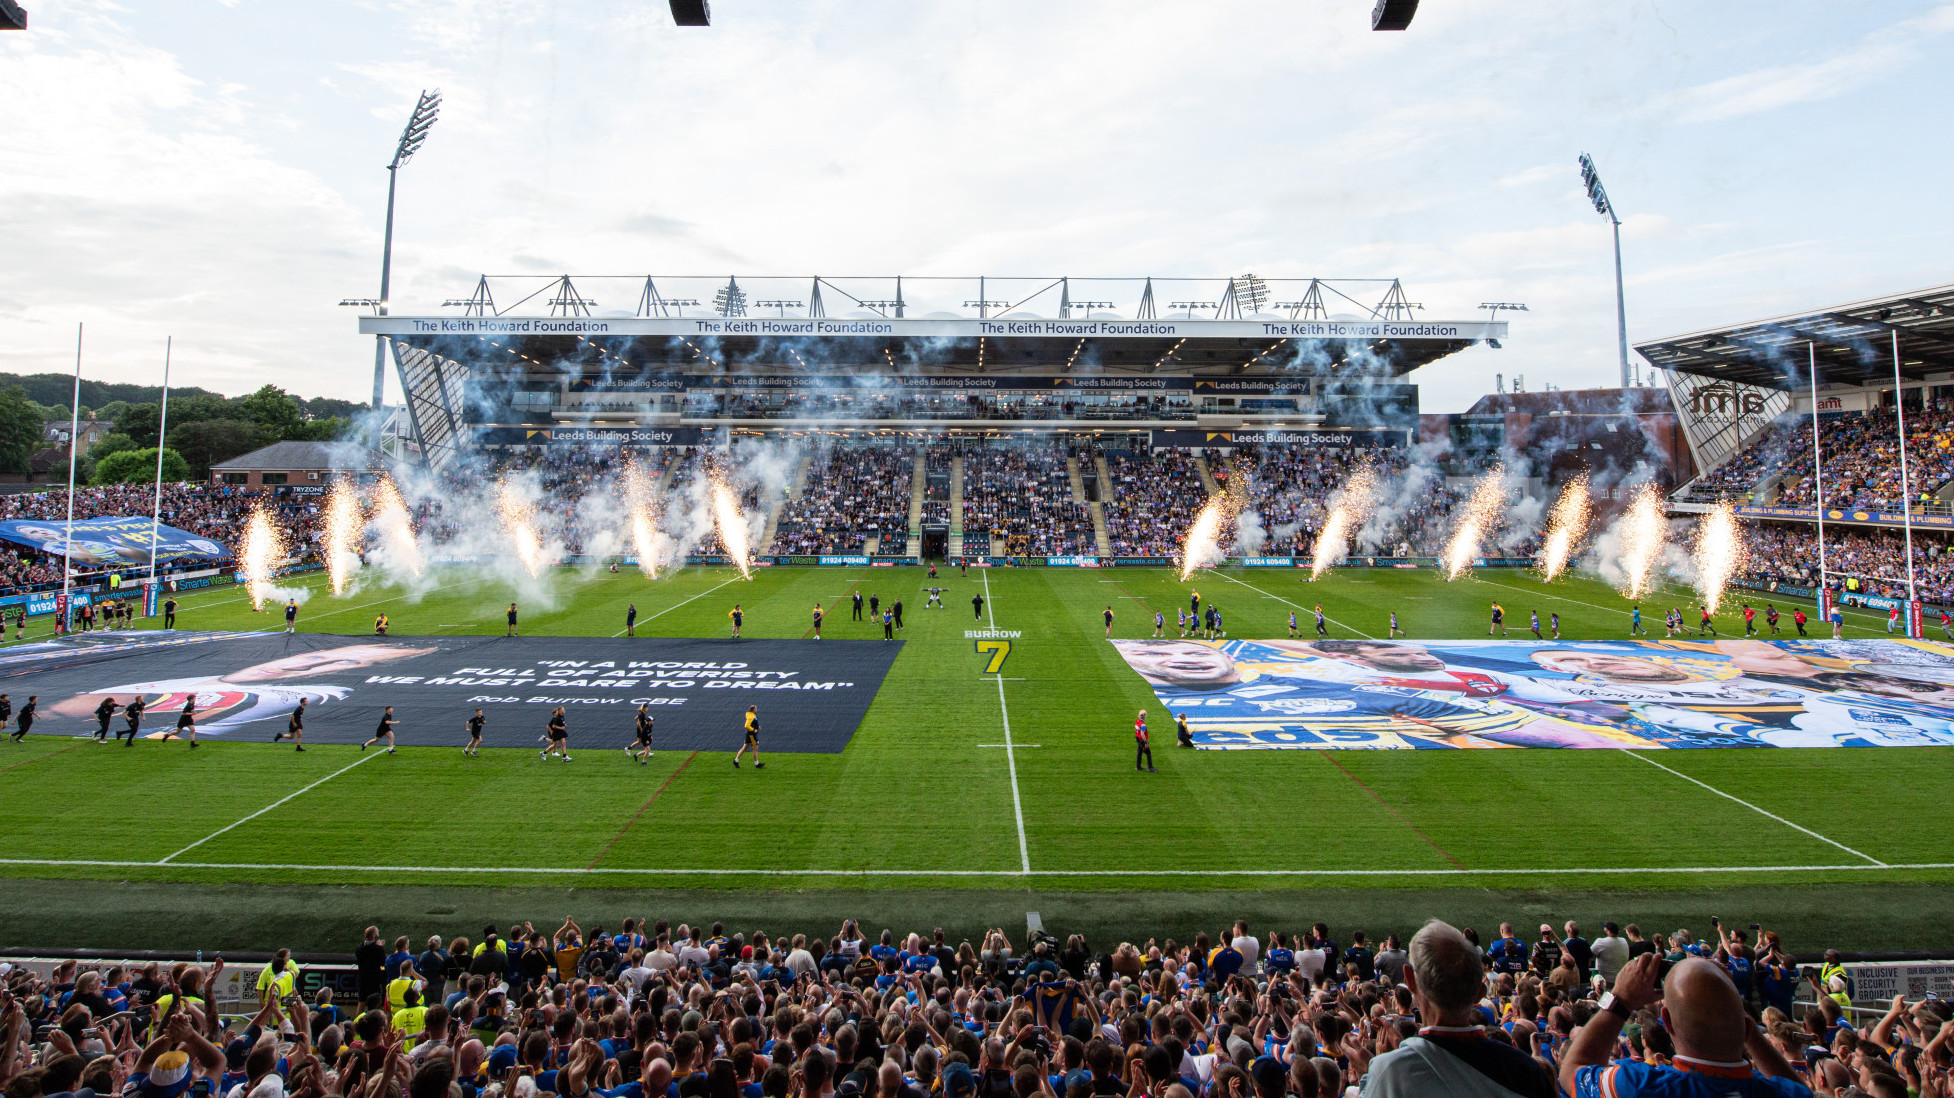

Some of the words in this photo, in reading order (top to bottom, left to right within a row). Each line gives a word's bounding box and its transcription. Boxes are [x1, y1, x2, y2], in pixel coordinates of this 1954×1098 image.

[413, 320, 430, 332] The
[441, 320, 475, 332] Keith
[479, 320, 530, 332] Howard
[534, 320, 608, 332] Foundation
[696, 321, 721, 333] The
[725, 321, 758, 333] Keith
[762, 321, 813, 333] Howard
[818, 321, 892, 333] Foundation
[980, 322, 1004, 334] The
[1008, 322, 1042, 334] Keith
[1046, 322, 1097, 334] Howard
[1101, 322, 1175, 334] Foundation
[1263, 323, 1289, 335] The
[1291, 323, 1325, 335] Keith
[1328, 323, 1379, 335] Howard
[1384, 323, 1457, 336] Foundation
[591, 379, 616, 387] Leeds
[617, 379, 650, 389] Building
[651, 379, 683, 389] Society
[732, 377, 757, 385] Leeds
[759, 377, 790, 387] Building
[790, 377, 824, 387] Society
[903, 377, 929, 386] Leeds
[930, 377, 963, 388] Building
[964, 378, 997, 388] Society
[1073, 378, 1099, 387] Leeds
[1100, 378, 1133, 389] Building
[1134, 378, 1166, 389] Society
[1215, 381, 1239, 390] Leeds
[1241, 381, 1274, 391] Building
[1274, 381, 1307, 391] Society
[1817, 397, 1842, 409] amt
[552, 430, 584, 440] Leeds
[586, 430, 629, 442] Building
[631, 430, 672, 442] Society
[1231, 433, 1265, 443] Leeds
[1266, 433, 1309, 445] Building
[1310, 433, 1352, 445] Society
[1768, 508, 1793, 516] PLUMBING
[1879, 513, 1905, 521] BUILDIN
[1916, 515, 1952, 524] PLUMBING
[179, 574, 234, 591] SmarterWaste
[30, 600, 57, 613] 01924
[964, 630, 1022, 638] BURROW
[974, 640, 1012, 674] 7
[628, 661, 748, 669] WORLD
[452, 668, 536, 677] FULL
[547, 669, 600, 677] OF
[600, 670, 800, 679] ADVERISTY
[364, 675, 425, 685] WE
[424, 677, 536, 686] MUST
[536, 679, 640, 688] DARE
[649, 680, 696, 689] TO
[466, 695, 520, 704] Rob
[525, 696, 624, 705] Burrow
[630, 698, 689, 706] CBE
[1857, 967, 1899, 978] INCLUSIVE
[1918, 966, 1942, 975] BUSINESS
[304, 972, 358, 991] SHE
[1858, 978, 1897, 989] SECURITY
[1858, 990, 1885, 1000] GROUP
